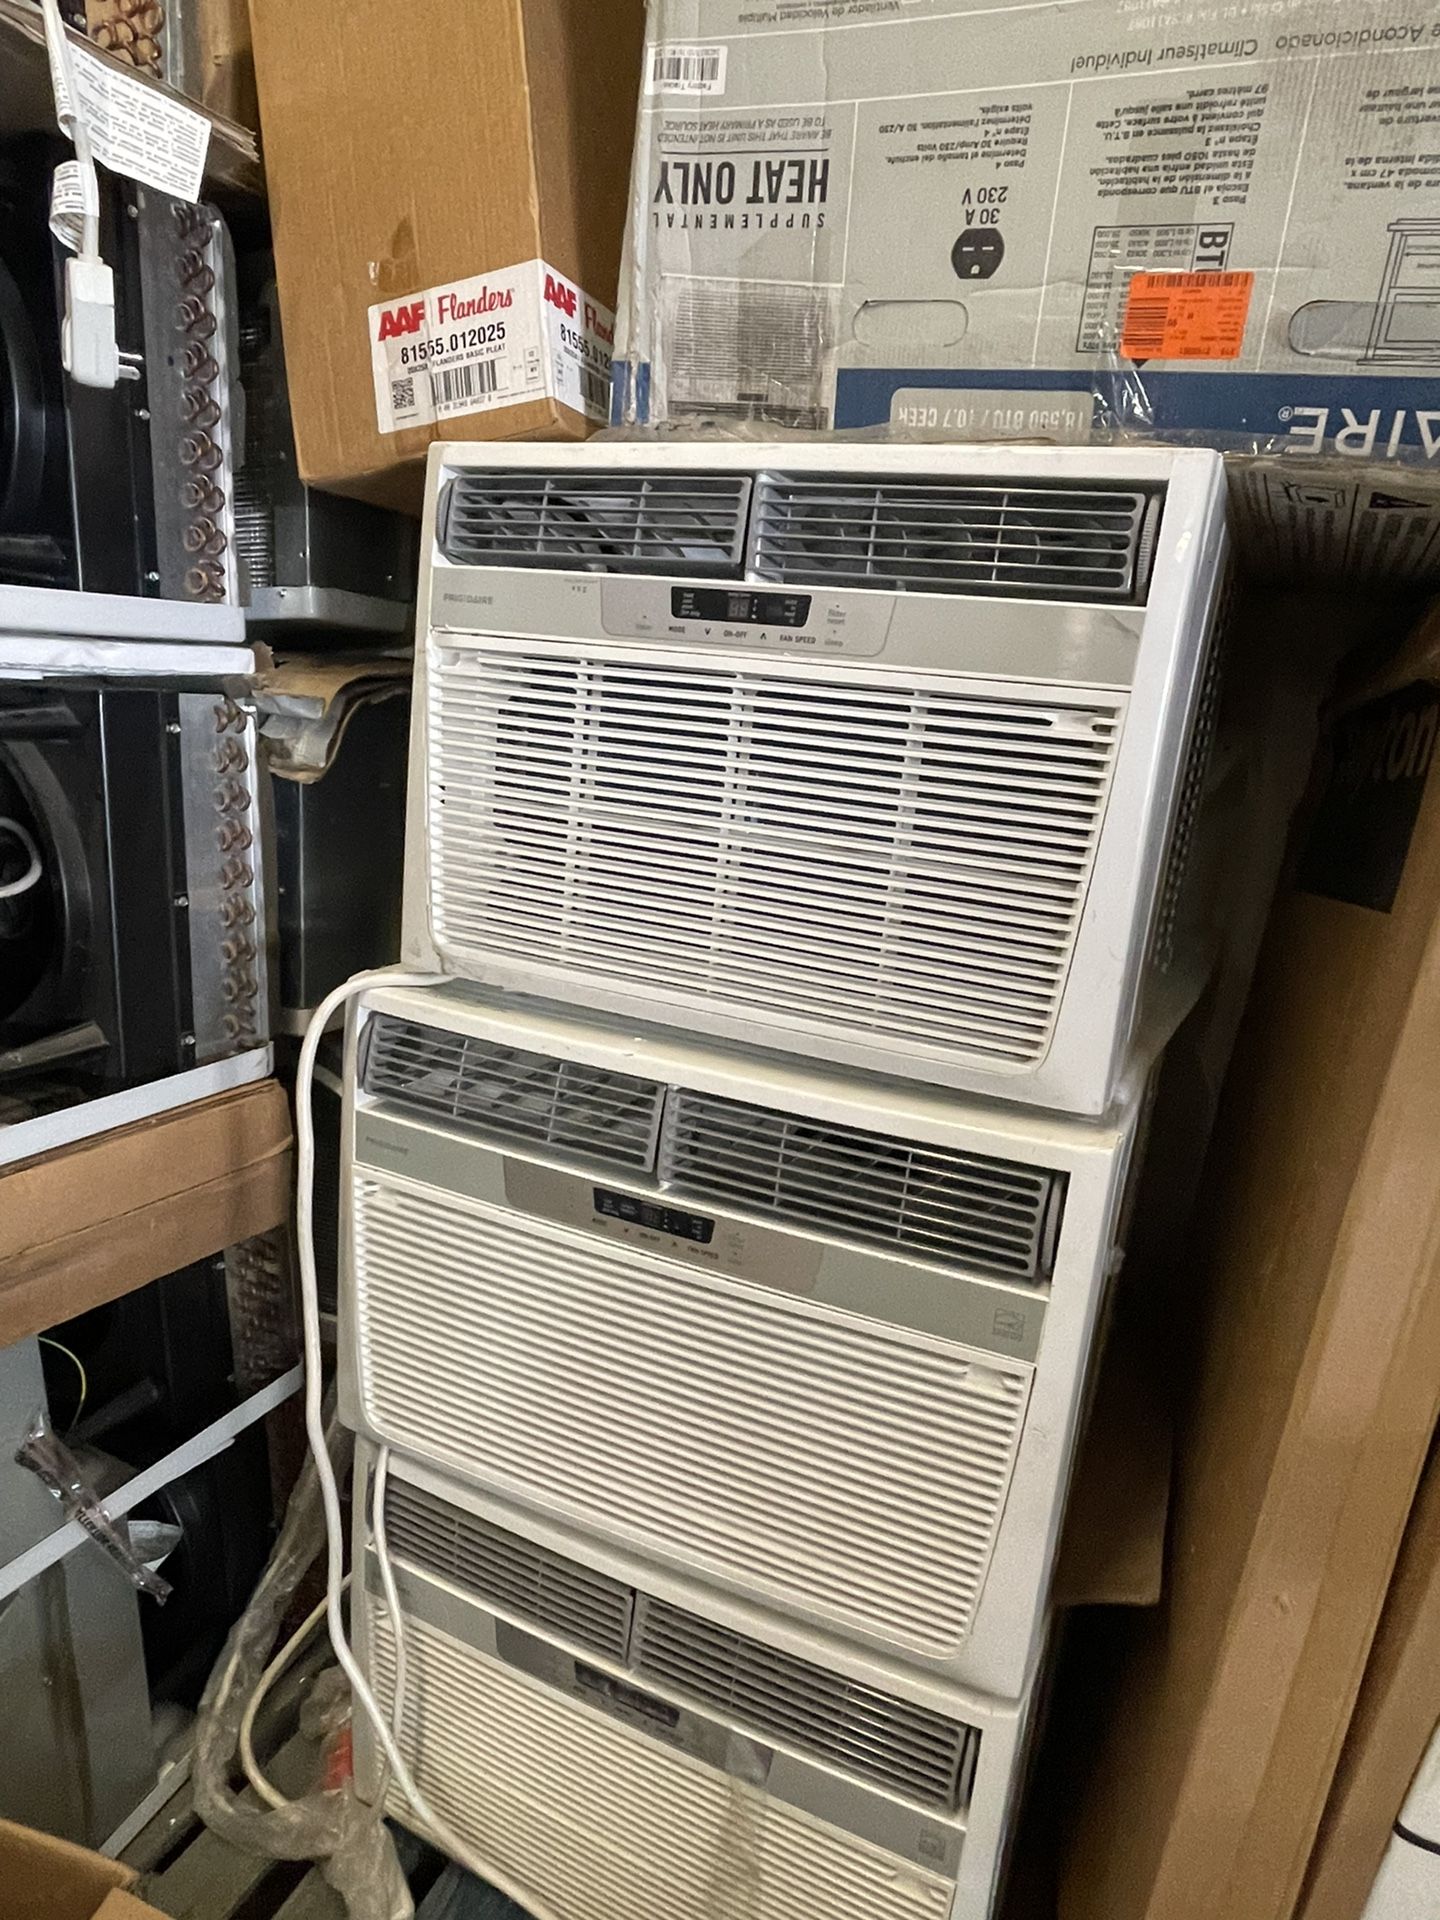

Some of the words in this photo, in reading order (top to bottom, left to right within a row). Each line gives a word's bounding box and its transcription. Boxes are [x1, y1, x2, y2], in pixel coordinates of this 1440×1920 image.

[832, 7, 845, 17] de
[848, 1, 900, 15] Ventilador
[780, 9, 829, 20] Velocidad
[1275, 25, 1424, 51] Acondicionado
[1156, 39, 1258, 62] Climatiseur
[1071, 49, 1152, 72] Individuel
[1366, 90, 1380, 100] de
[1012, 104, 1032, 113] volts
[1151, 104, 1173, 114] salle
[1175, 102, 1193, 111] une
[1196, 100, 1237, 111] refroidit
[1201, 110, 1244, 121] convient
[1246, 108, 1264, 118] qui
[758, 120, 764, 129] A
[766, 119, 776, 128] AS
[778, 118, 800, 128] USED
[802, 118, 813, 127] BE
[813, 117, 825, 127] TO
[1096, 120, 1121, 129] Cette
[1124, 117, 1161, 127] surface.
[1164, 115, 1190, 125] votre
[663, 121, 698, 130] SOURCE
[700, 121, 719, 130] HEAT
[719, 121, 756, 130] PRIMARY
[1196, 126, 1206, 135] la
[768, 131, 789, 141] THAT
[791, 131, 819, 140] AWARE
[821, 129, 832, 139] BE
[1103, 130, 1130, 141] B.T.U.
[1132, 130, 1144, 138] en
[1147, 126, 1195, 137] puissance
[658, 133, 699, 143] INTENDED
[700, 133, 716, 143] NOT
[717, 134, 725, 143] IS
[726, 133, 746, 142] UNIT
[748, 133, 766, 142] THIS
[994, 138, 1028, 146] Require
[1205, 138, 1211, 146] 3
[981, 149, 1027, 159] Determine
[1161, 151, 1182, 162] pies
[1212, 150, 1240, 159] hasta
[1243, 149, 1256, 157] de
[922, 155, 935, 163] del
[1003, 160, 1025, 168] Paso
[1106, 154, 1159, 164] cuadrados.
[1345, 158, 1355, 166] la
[1357, 157, 1373, 166] de
[1375, 155, 1415, 164] interna
[1194, 161, 1229, 171] unidad
[1231, 160, 1254, 169] Esta
[1089, 167, 1140, 176] habitación
[1233, 172, 1242, 180] la
[1360, 169, 1377, 177] cm
[1380, 169, 1394, 178] 47
[653, 161, 735, 205] ONLY
[746, 159, 829, 204] HEAT
[1097, 176, 1150, 187] habitación.
[1152, 176, 1161, 184] la
[1164, 175, 1176, 183] de
[1179, 173, 1230, 183] dimensión
[1160, 185, 1178, 194] que
[1180, 185, 1201, 194] BTU
[1204, 185, 1214, 193] el
[1217, 182, 1249, 193] Escoja
[1344, 181, 1390, 190] ventana.
[1394, 181, 1404, 190] la
[1408, 181, 1421, 190] de
[962, 188, 971, 205] V
[977, 186, 1008, 204] 230
[1097, 186, 1157, 198] corresponda
[1213, 196, 1219, 205] 3
[1222, 195, 1247, 204] Paso
[653, 213, 825, 229] SUPPLEMENTAL
[965, 209, 975, 226] A
[980, 208, 1000, 224] 30
[544, 273, 576, 318] AAF
[378, 301, 425, 342] AAF
[438, 286, 512, 324] Flanders
[401, 321, 505, 364] 81555.012025
[466, 350, 484, 360] BASIC
[486, 343, 505, 354] PLEAT
